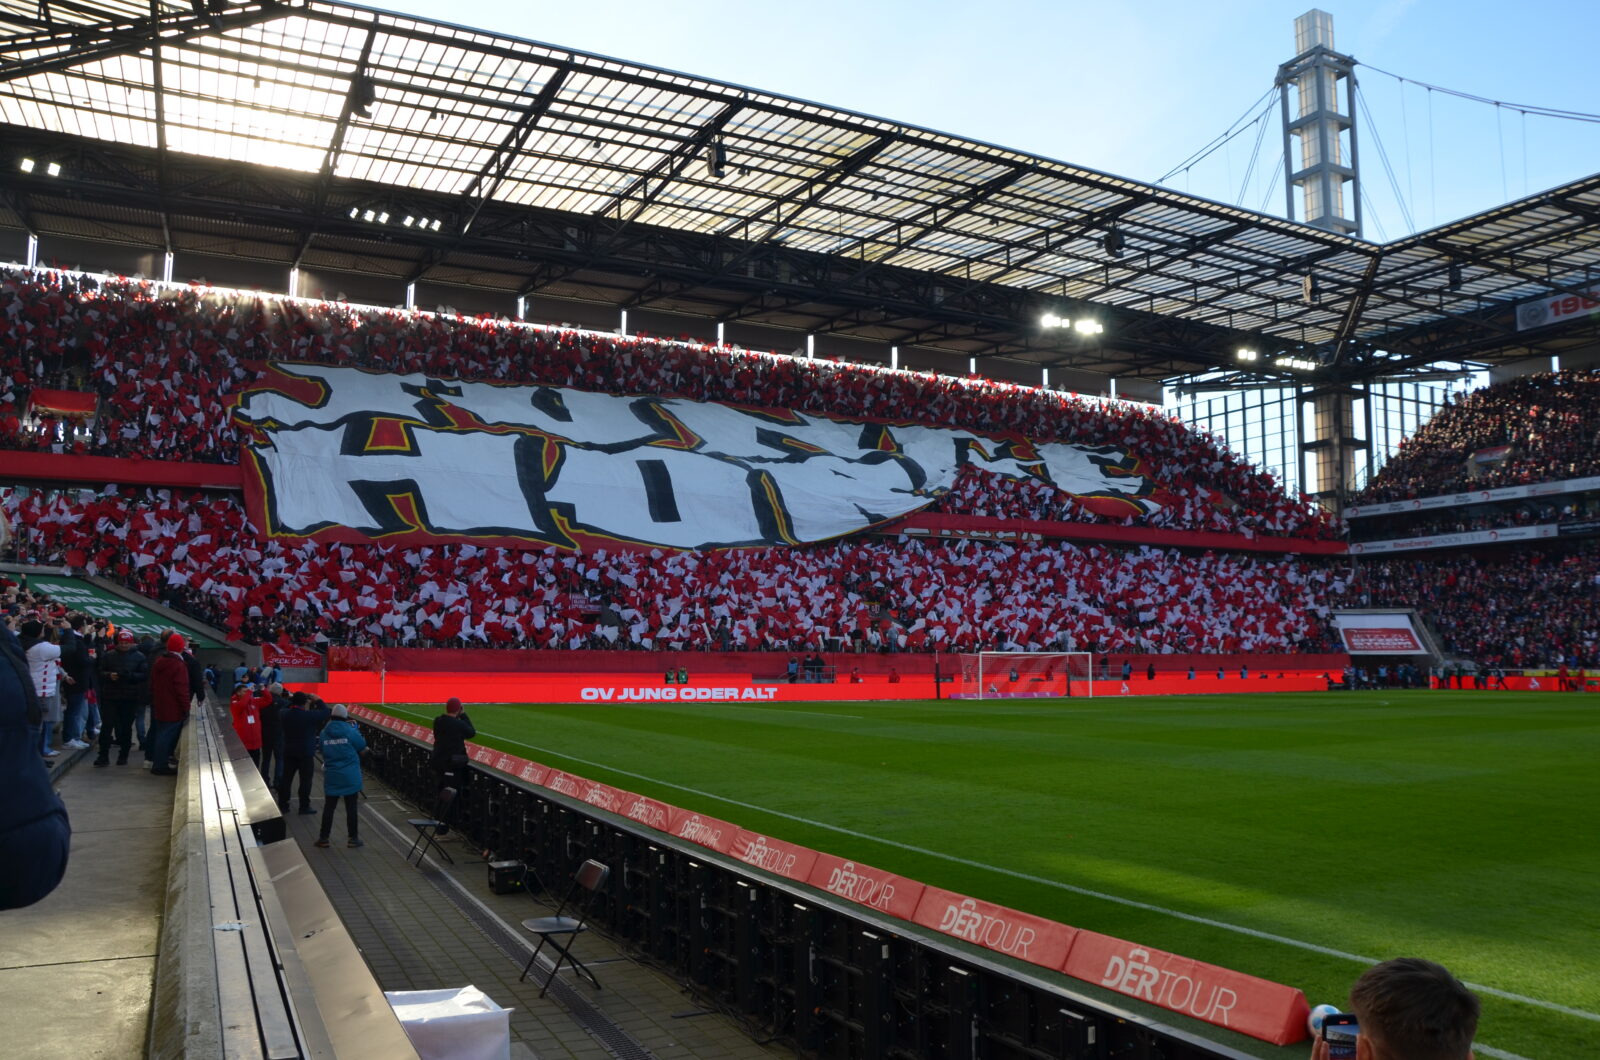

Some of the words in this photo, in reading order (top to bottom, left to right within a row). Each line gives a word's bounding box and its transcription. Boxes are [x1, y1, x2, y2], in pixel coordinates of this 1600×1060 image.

[580, 687, 615, 700] OV
[617, 687, 676, 700] JUNG
[679, 687, 739, 700] ODER
[740, 687, 778, 700] ALT
[743, 841, 797, 876] DERTOUR
[827, 867, 896, 911] DERTOUR
[939, 904, 1037, 959] DERTOUR
[1102, 955, 1238, 1026] DERTOUR
